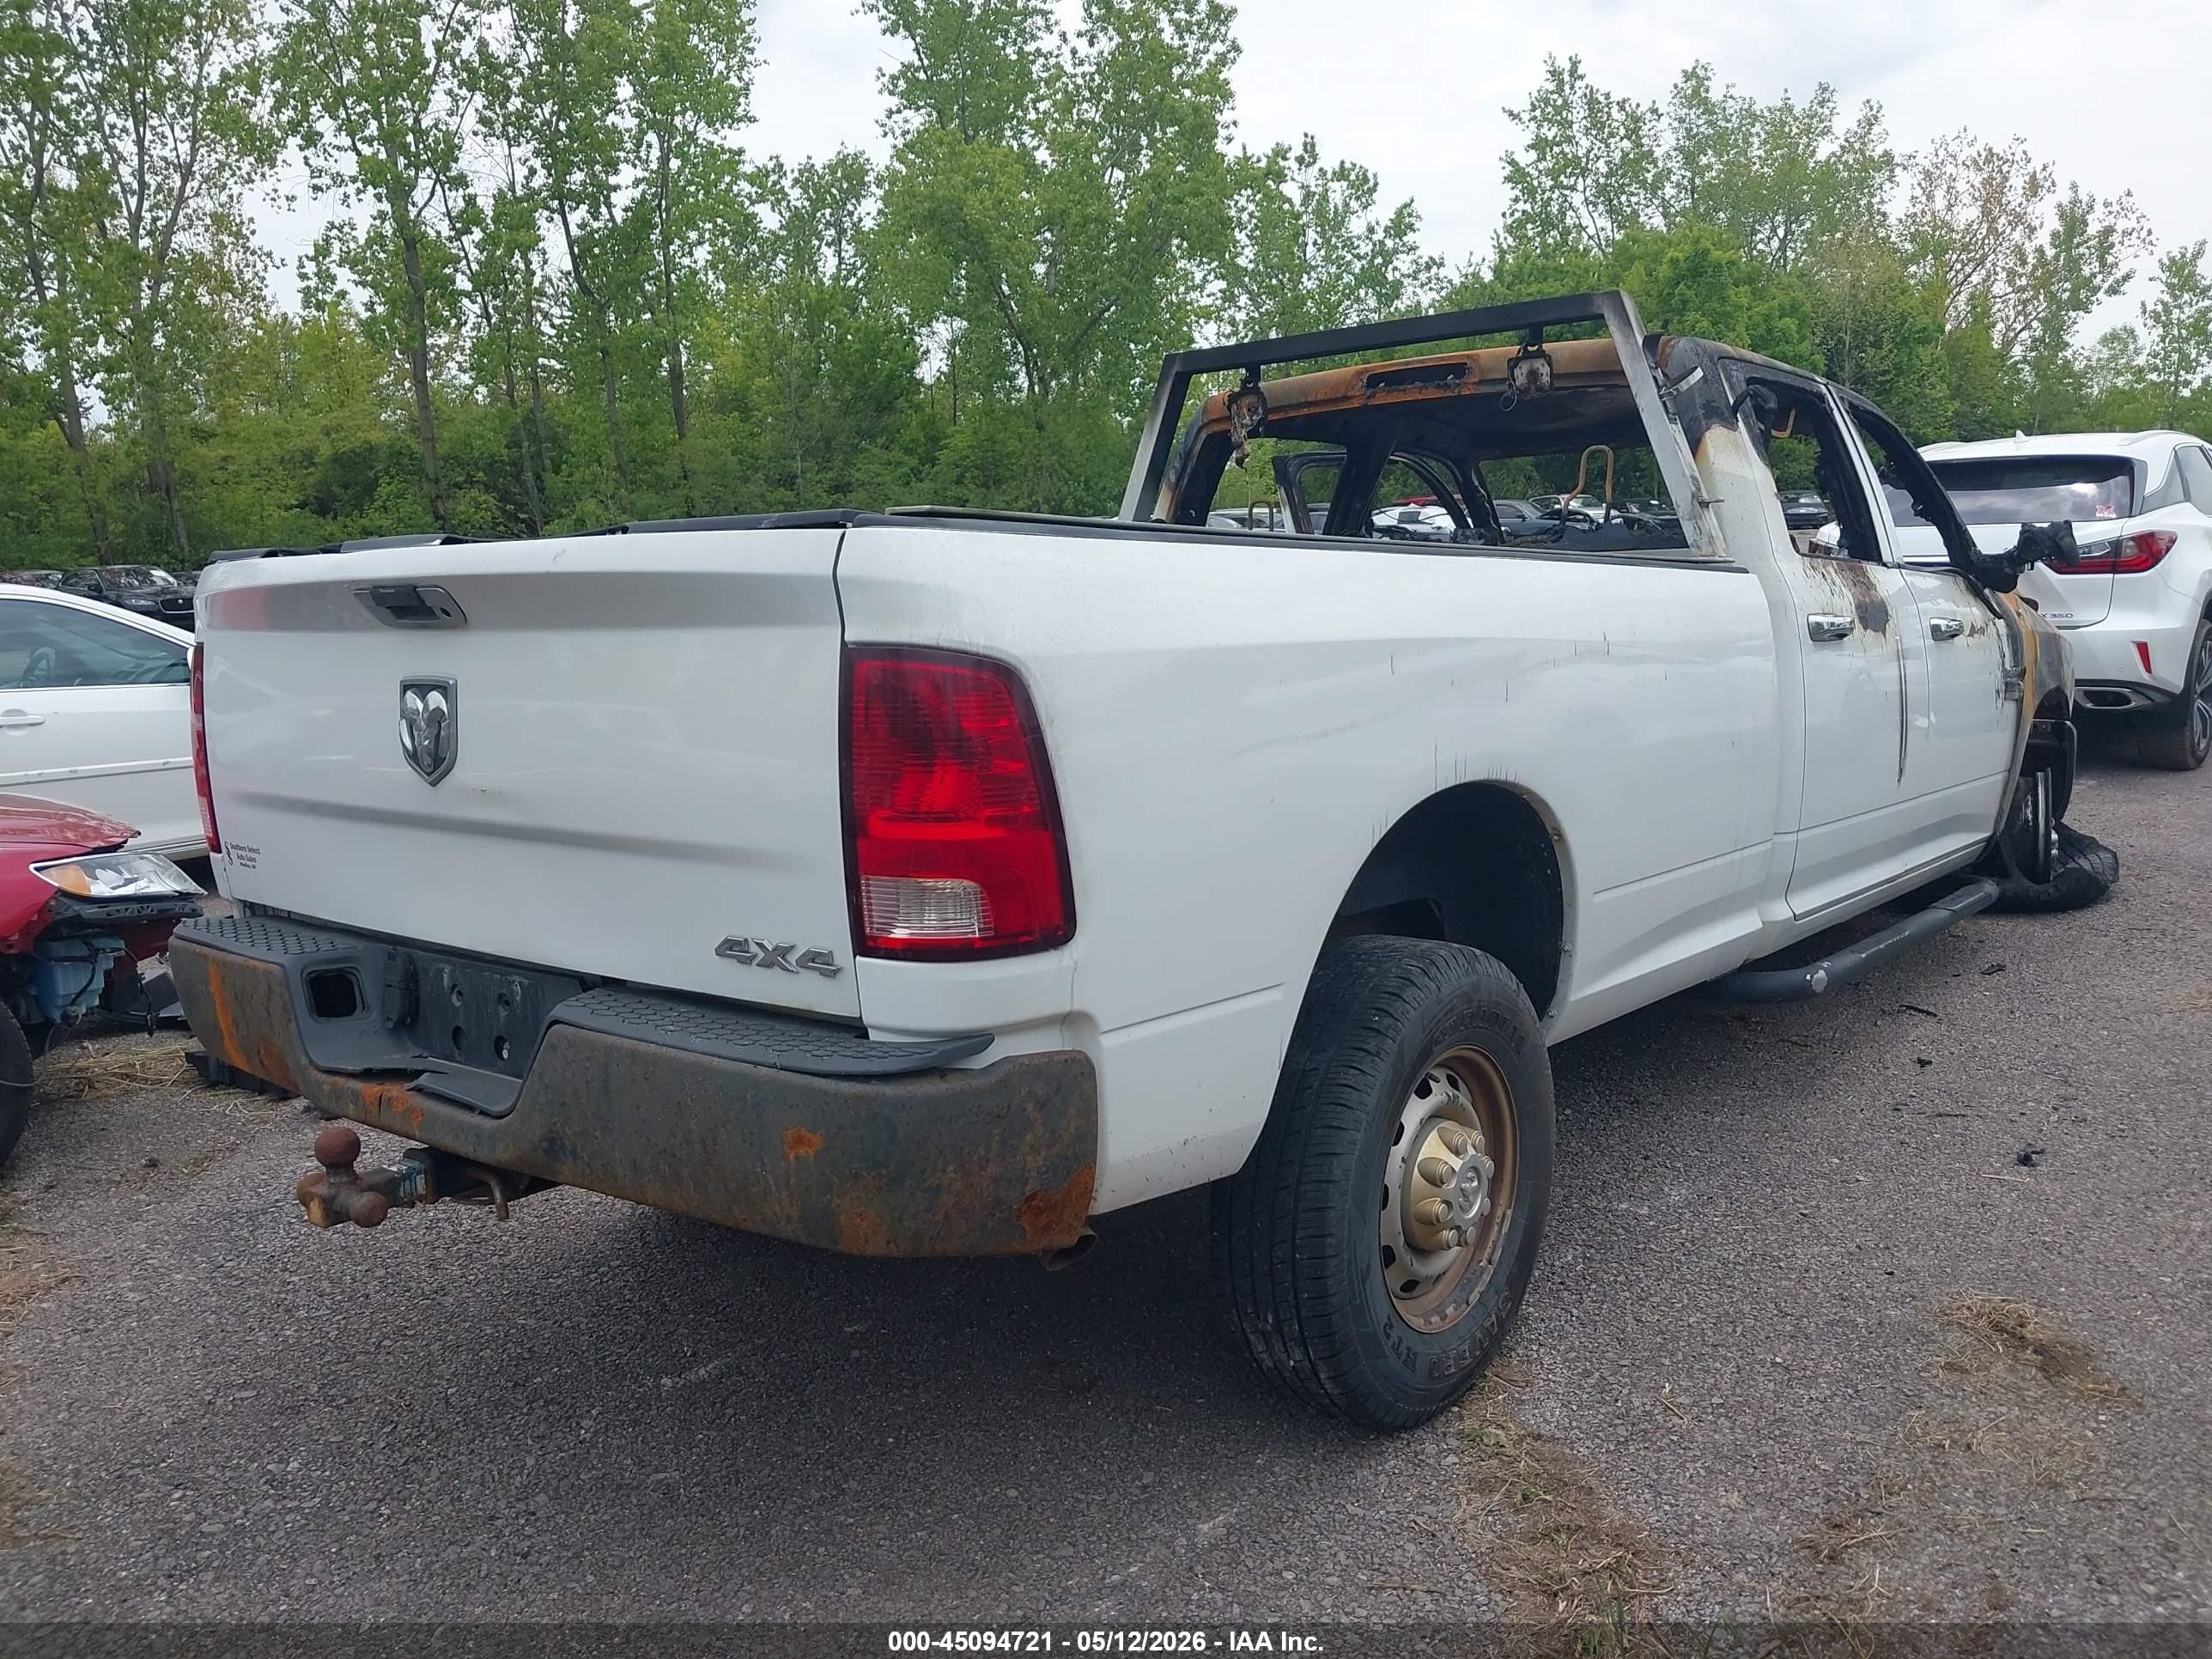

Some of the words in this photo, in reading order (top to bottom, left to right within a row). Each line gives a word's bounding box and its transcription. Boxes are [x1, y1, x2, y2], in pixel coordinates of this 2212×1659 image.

[229, 842, 246, 852] Southern
[246, 844, 261, 855] Select
[236, 852, 246, 861] Auto
[246, 854, 257, 864] Sales
[1459, 1007, 1527, 1056] RADIAL
[1428, 1293, 1514, 1378] SAVERO
